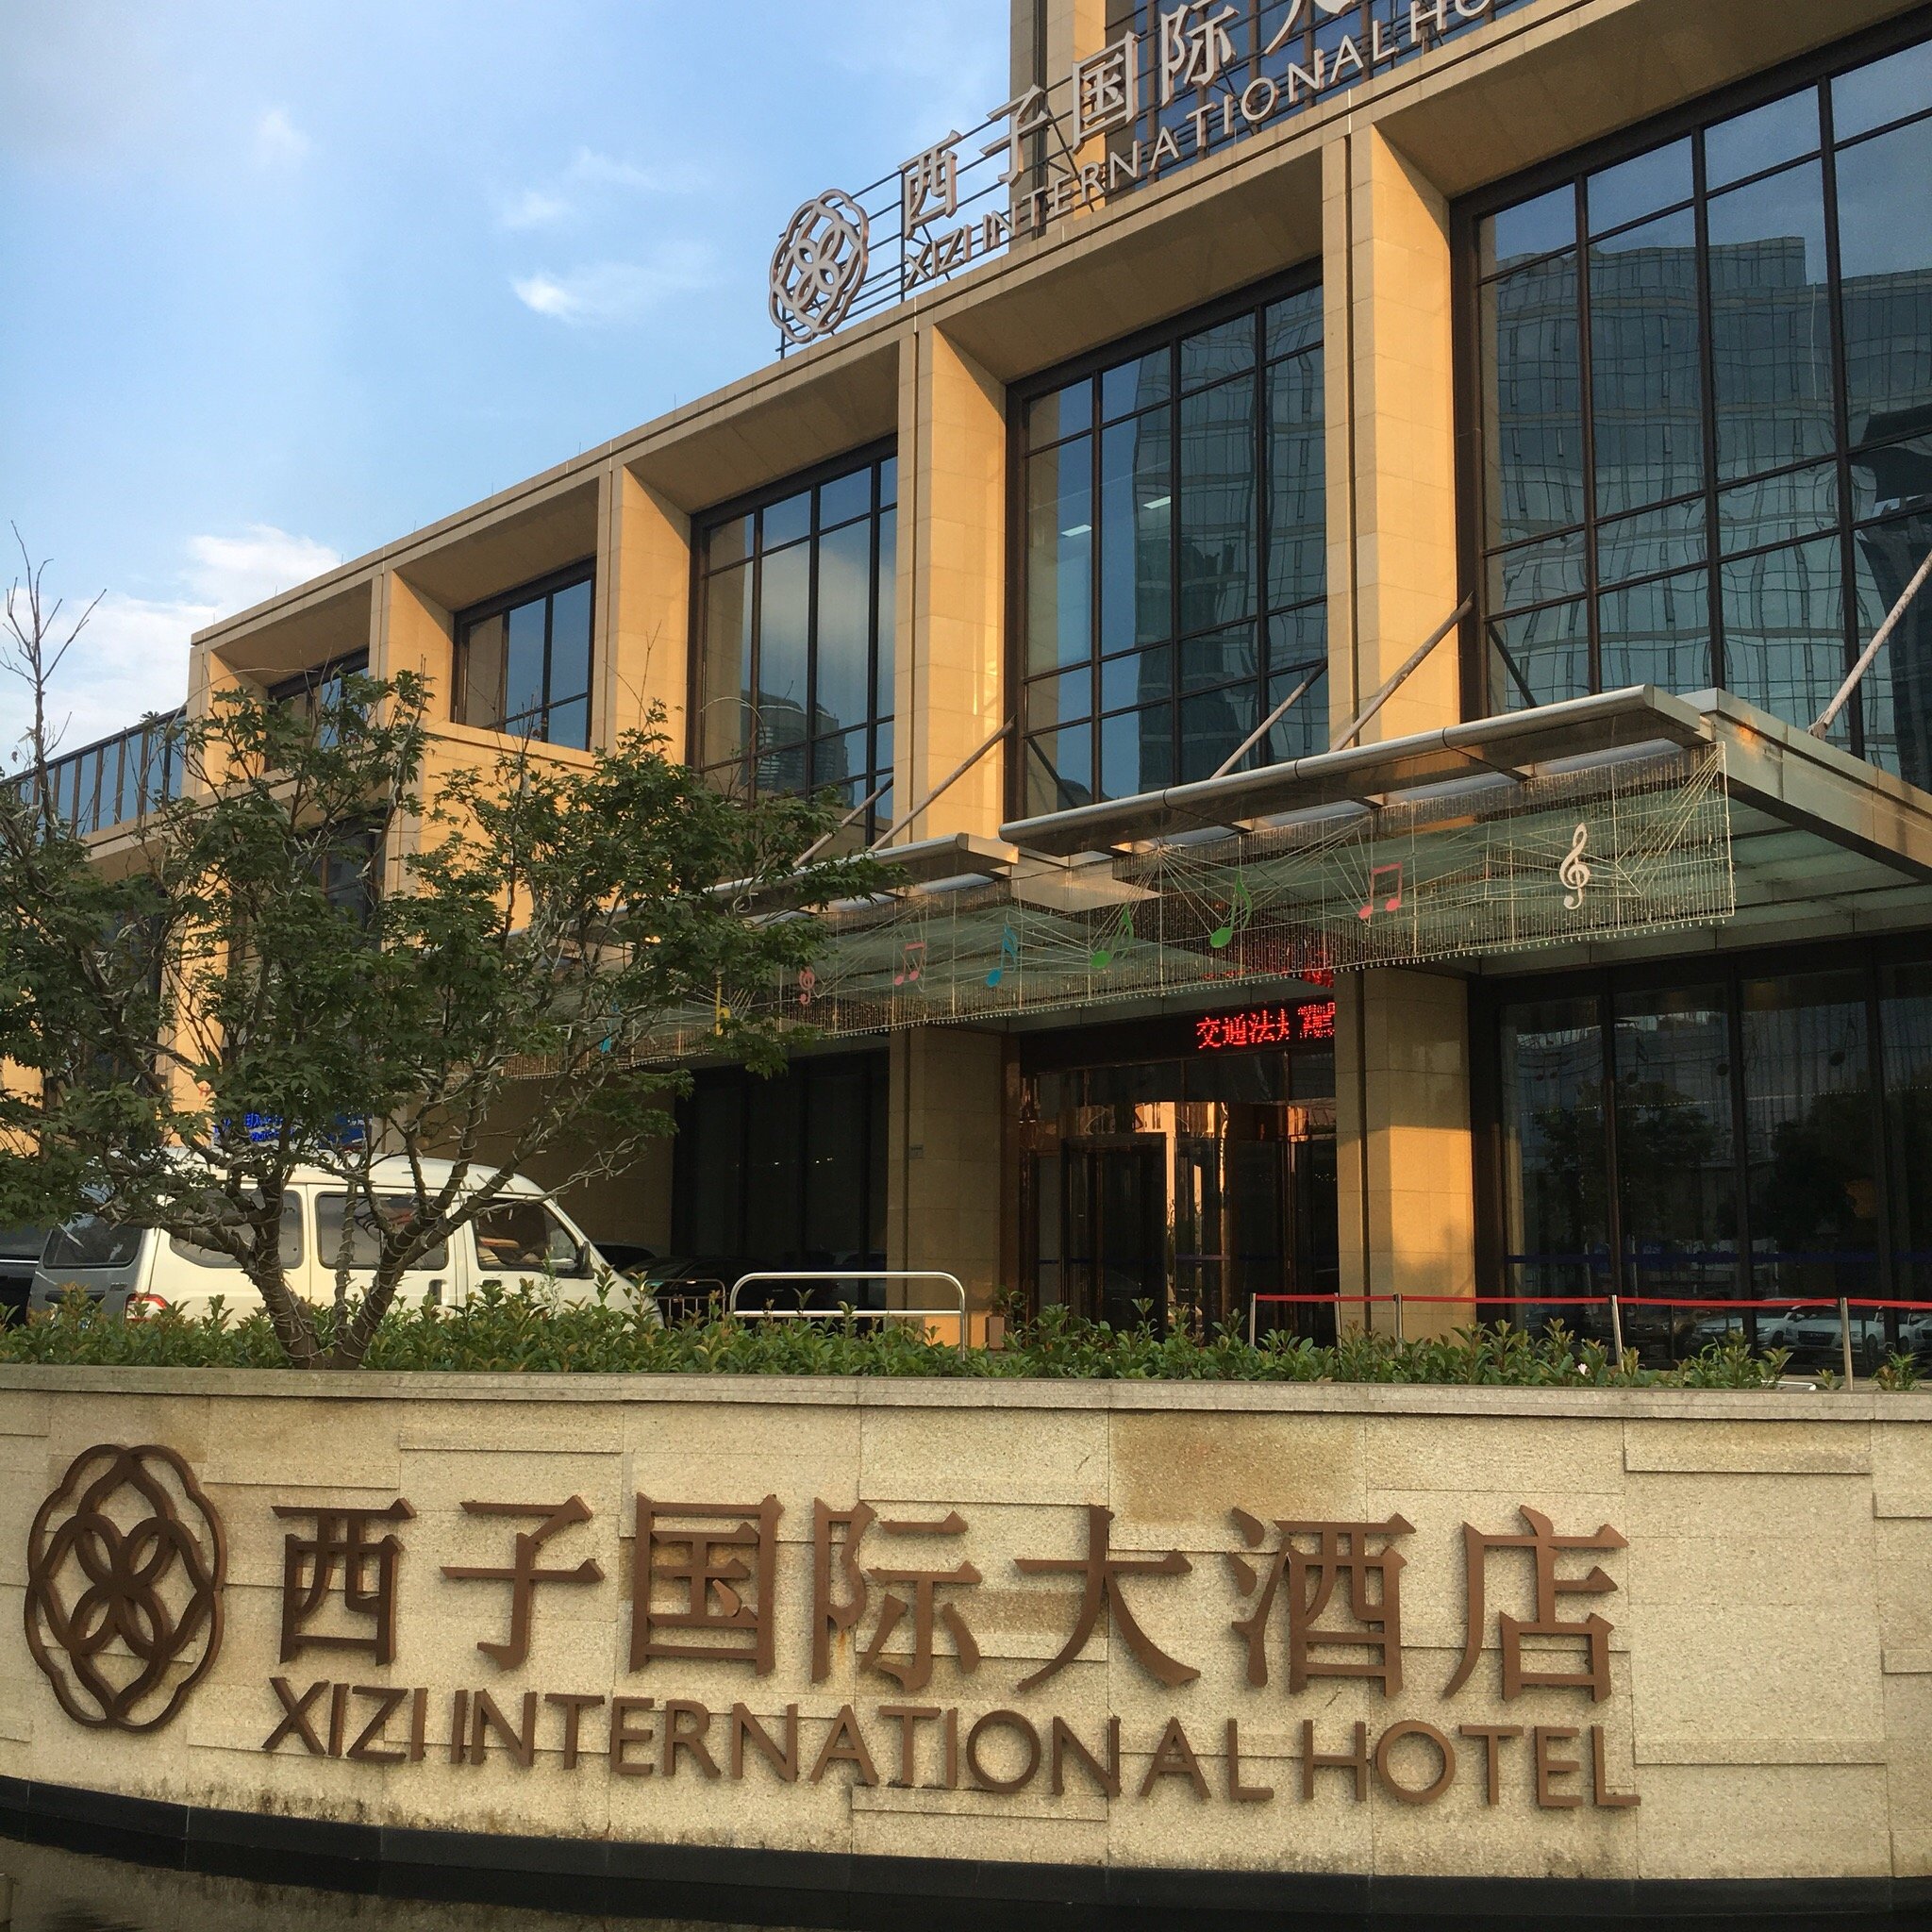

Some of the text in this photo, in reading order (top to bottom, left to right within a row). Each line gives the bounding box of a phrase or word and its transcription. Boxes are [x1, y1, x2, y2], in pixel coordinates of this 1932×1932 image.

[903, 224, 973, 291] XIZI
[983, 19, 1400, 253] INTERNATIONAL
[271, 1492, 1629, 1701] 西子国际大酒店
[261, 1676, 1642, 1807] XIZI INTERNATIONAL HOTEL
